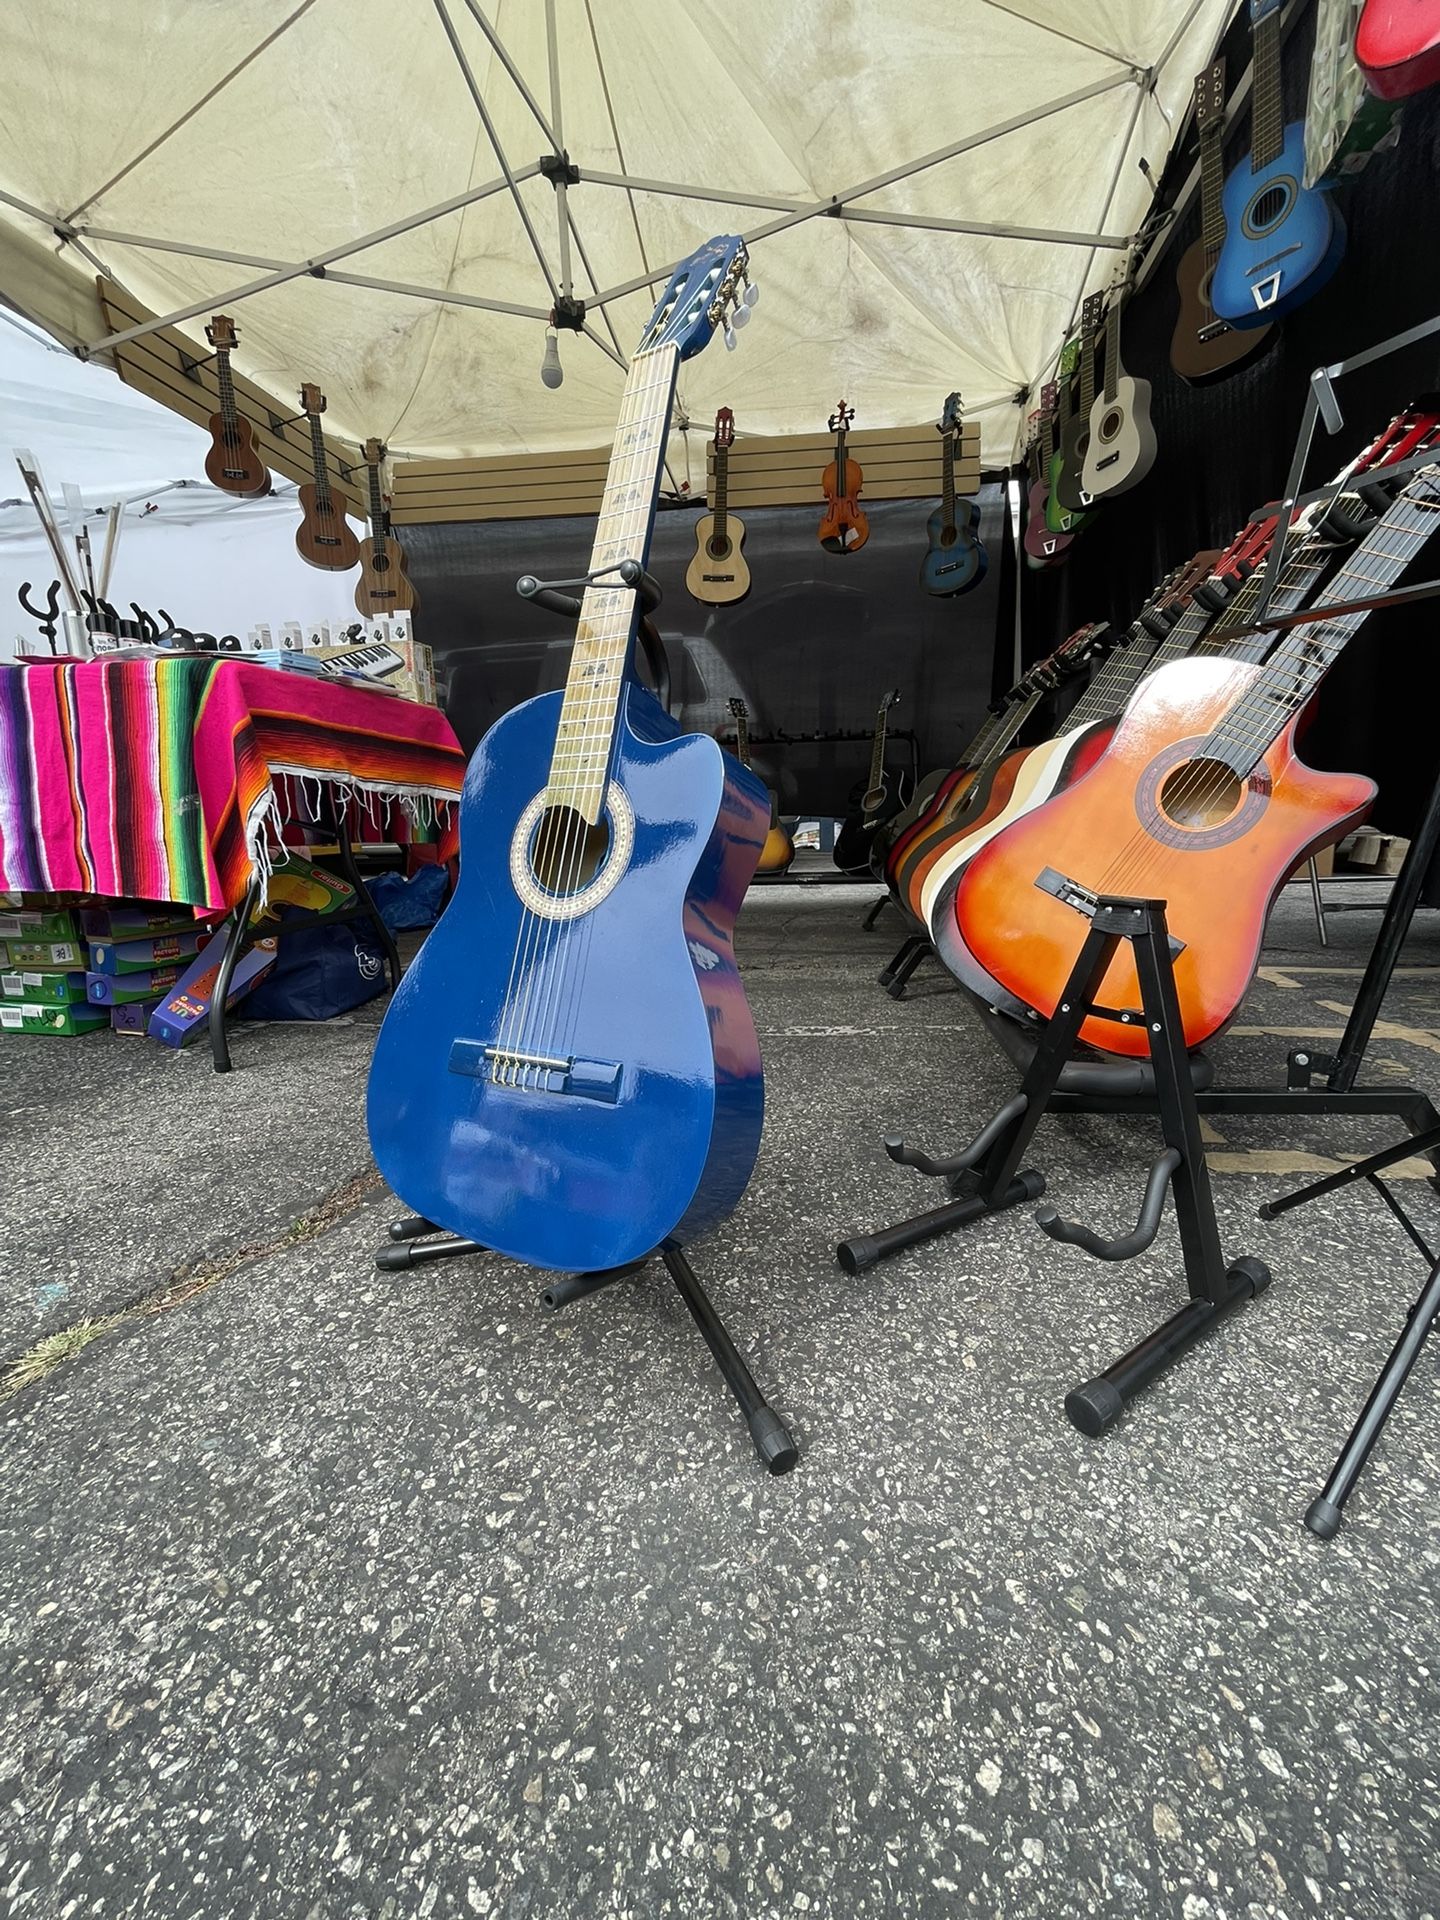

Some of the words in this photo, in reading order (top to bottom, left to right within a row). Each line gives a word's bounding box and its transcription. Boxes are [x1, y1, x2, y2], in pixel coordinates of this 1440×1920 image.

[318, 873, 344, 890] Guitar
[153, 947, 180, 956] FACTORY
[151, 974, 177, 985] FACTORY
[167, 1003, 196, 1020] FUN
